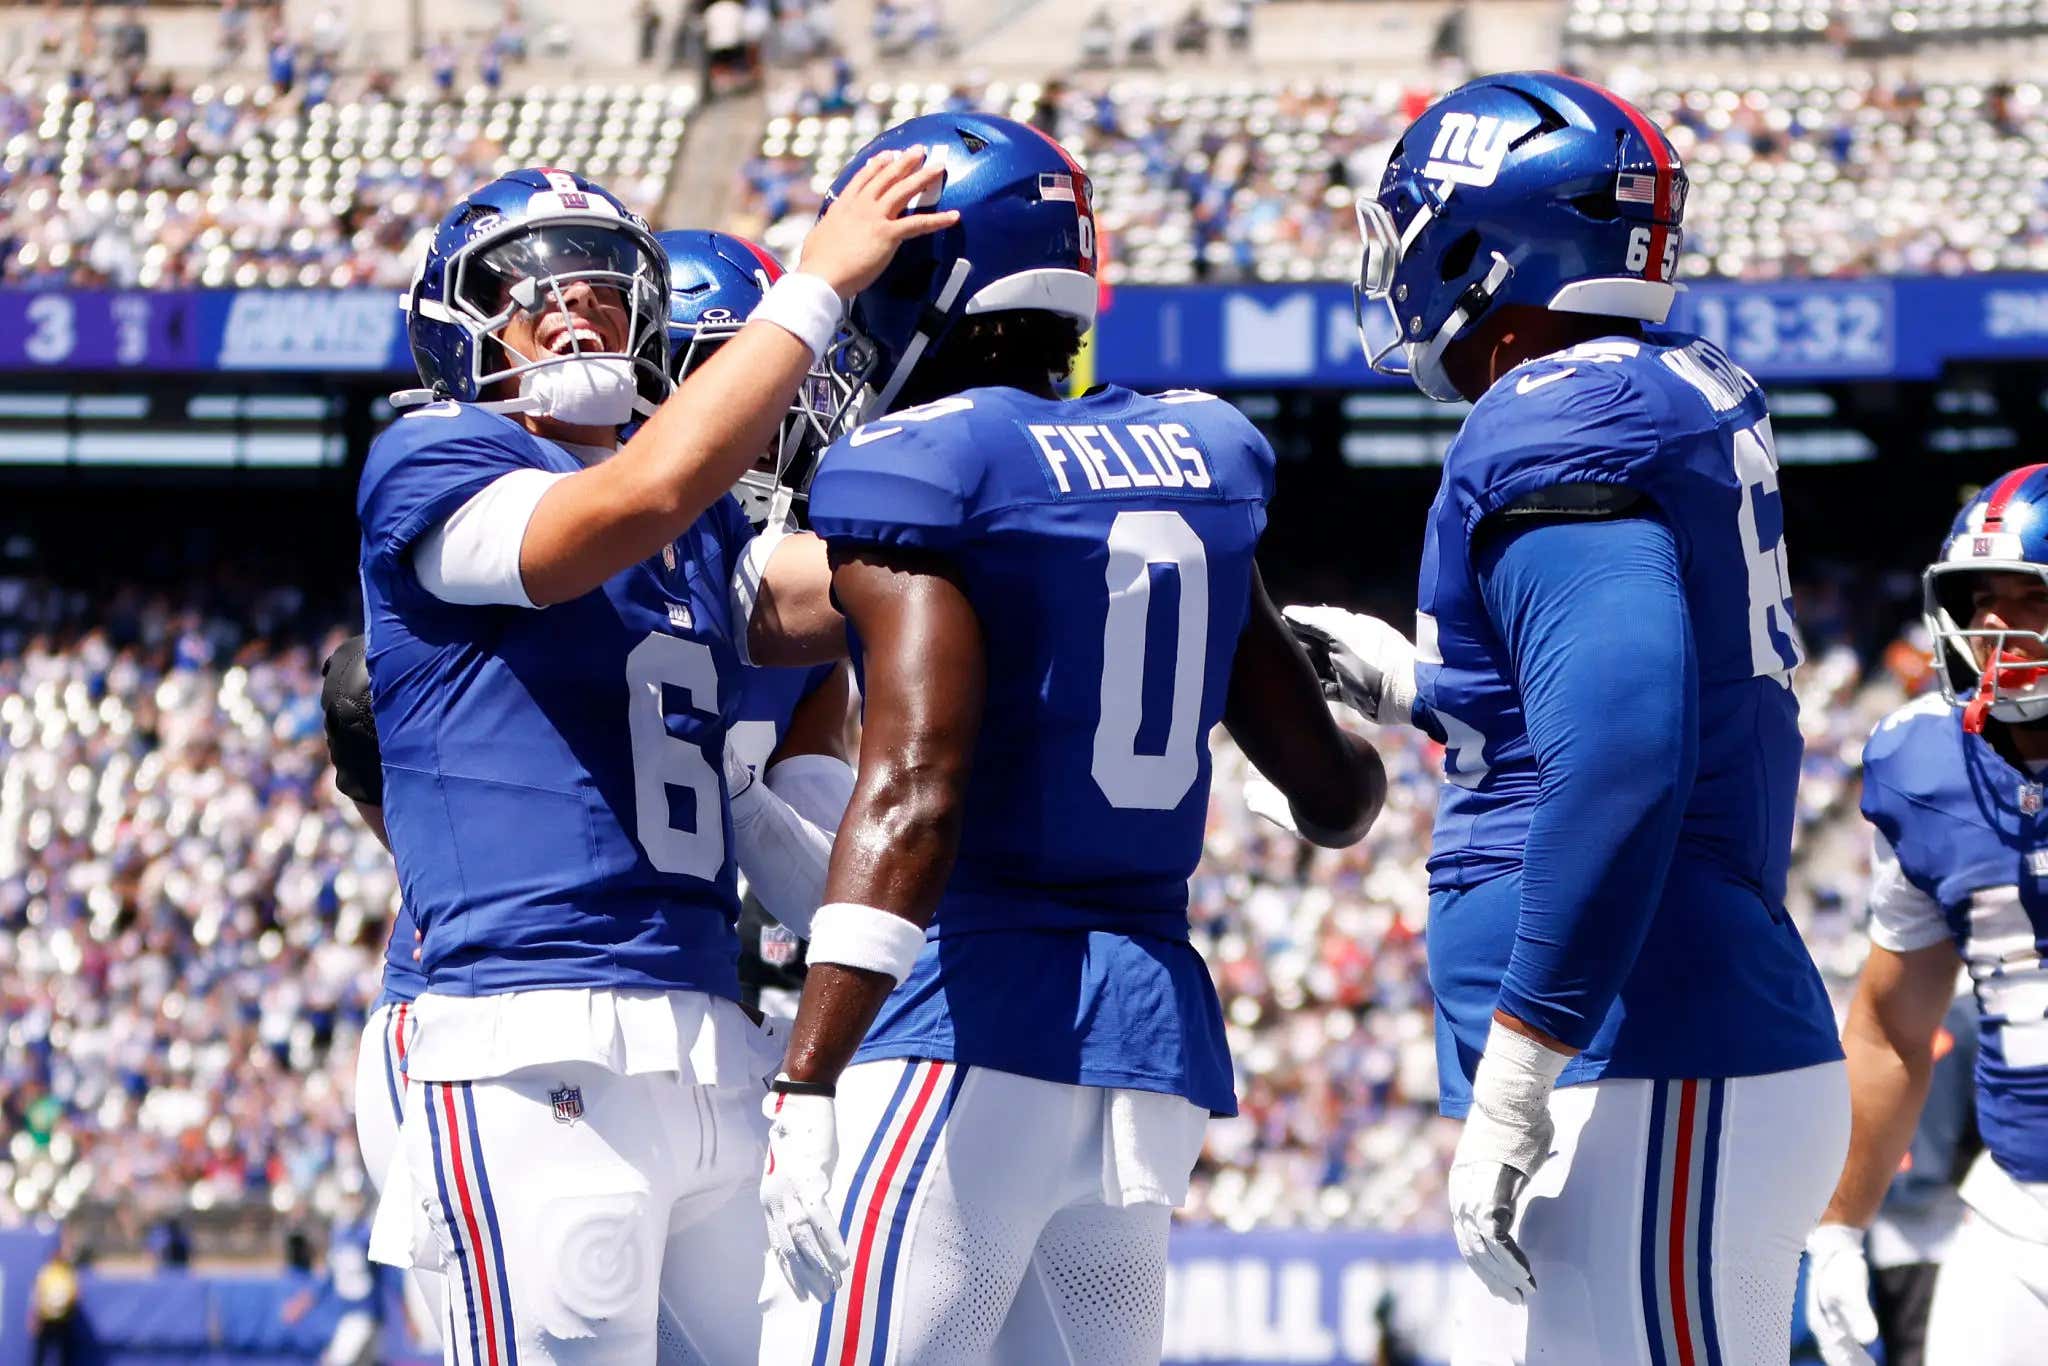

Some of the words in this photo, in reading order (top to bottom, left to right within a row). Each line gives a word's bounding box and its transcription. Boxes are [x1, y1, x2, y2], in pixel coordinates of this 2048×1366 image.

[1079, 215, 1093, 258] 0
[24, 294, 76, 364] 3
[1029, 423, 1212, 493] FIELDS
[1091, 510, 1209, 810] 0
[626, 630, 725, 883] 6
